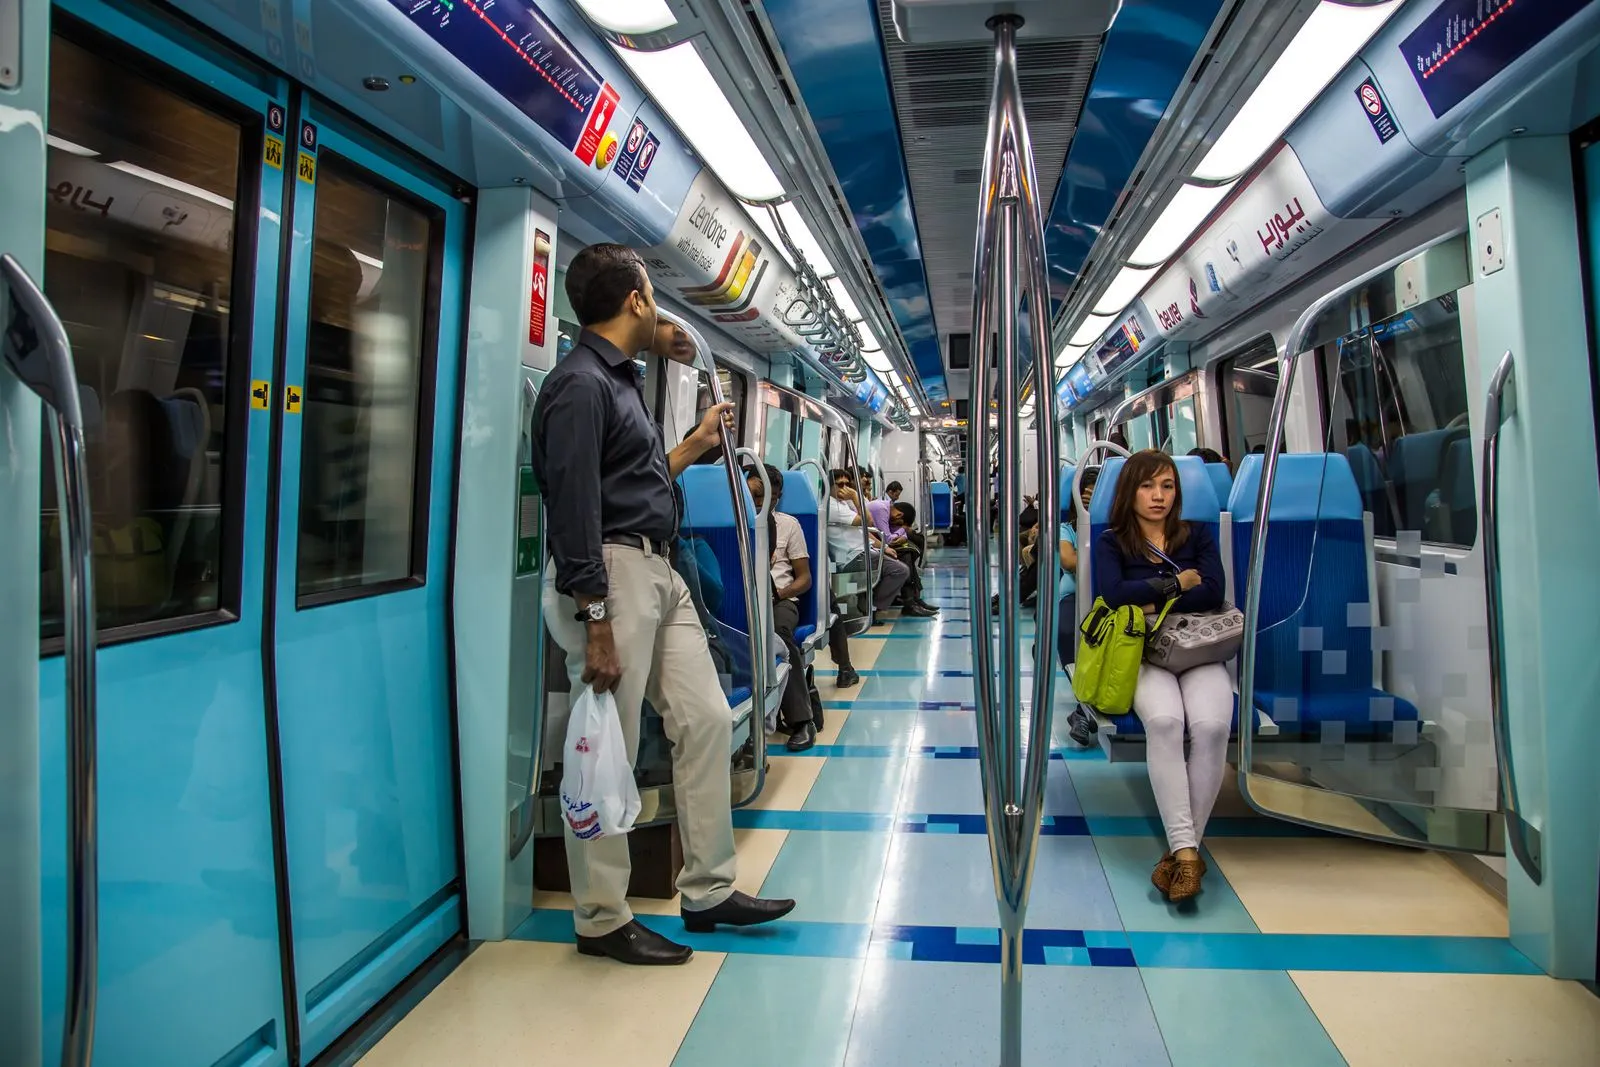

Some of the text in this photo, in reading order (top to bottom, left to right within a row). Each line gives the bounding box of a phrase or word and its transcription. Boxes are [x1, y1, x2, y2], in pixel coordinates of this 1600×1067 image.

[1257, 197, 1312, 256] بيورير
[676, 236, 691, 254] with
[1155, 302, 1184, 331] beurer
